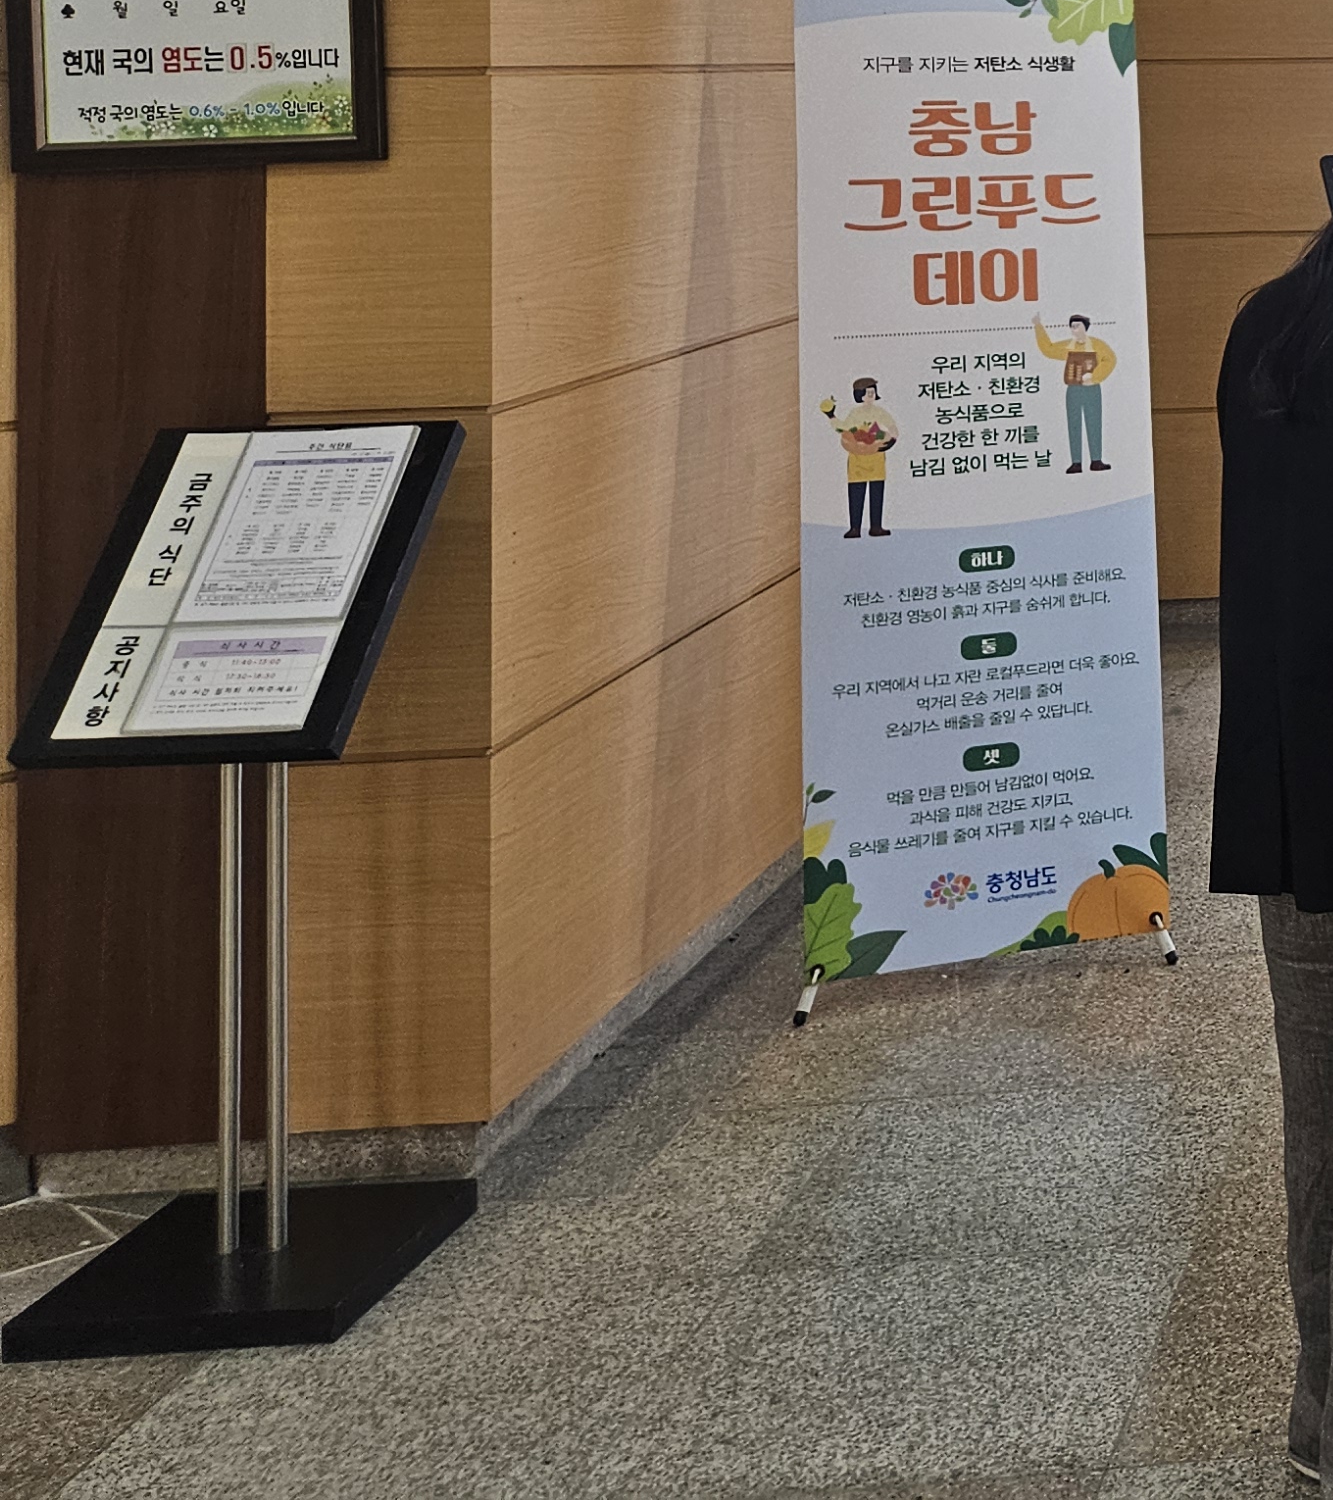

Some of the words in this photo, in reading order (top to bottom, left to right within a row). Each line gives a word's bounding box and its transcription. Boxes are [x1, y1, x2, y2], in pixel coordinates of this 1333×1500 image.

[113, 1, 128, 18] 월
[163, 0, 179, 17] 일
[62, 49, 105, 77] 현재
[113, 47, 153, 74] 국의
[162, 46, 224, 73] 염도는
[863, 55, 913, 73] 지구를
[919, 56, 968, 73] 지키는
[974, 56, 1022, 73] 저탄소
[1028, 55, 1075, 72] 식생활
[78, 107, 107, 123] 적정
[110, 104, 138, 121] 국의
[141, 104, 183, 122] 염도는
[189, 103, 225, 119] 0.6%
[243, 100, 325, 117] 1.0%입니다
[908, 100, 1037, 157] 충남
[843, 173, 1101, 232] 그린푸드
[913, 248, 1038, 306] 데이
[931, 355, 967, 374] 우리
[973, 351, 1026, 372] 지역의
[918, 380, 971, 399] 저탄소
[988, 376, 1040, 396] 친환경
[935, 402, 1024, 424] 농식품으로
[921, 429, 975, 451] 건강한
[980, 428, 997, 446] 한
[1004, 426, 1039, 444] 끼를
[910, 457, 945, 478] 남김
[951, 455, 988, 475] 없이
[993, 452, 1028, 472] 먹는
[1035, 450, 1052, 469] 날
[169, 472, 214, 536] 금주의
[148, 543, 183, 587] 식단
[971, 550, 1003, 568] 하나
[844, 590, 884, 607] 저탄소
[897, 584, 938, 602] 친환경
[942, 580, 982, 599] 농식품
[986, 575, 1026, 595] 중심의
[1029, 573, 1067, 590] 식사를
[1072, 567, 1126, 585] 준비해요.
[861, 610, 902, 628] 친환경
[907, 607, 947, 624] 영농이
[951, 603, 978, 620] 흙과
[982, 599, 1022, 616] 지구를
[1026, 595, 1066, 613] 숨쉬게
[1069, 590, 1111, 608] 합니다.
[981, 638, 997, 655] 둘
[84, 635, 140, 728] 공지사항
[833, 682, 860, 698] 우리
[865, 676, 919, 695] 지역에서
[924, 674, 951, 689] 나고
[955, 670, 982, 686] 자란
[985, 661, 1064, 682] 로컬푸드라면
[1069, 657, 1095, 673] 더욱
[1098, 651, 1139, 670] 좋아요.
[916, 692, 956, 710] 먹거리
[961, 690, 988, 707] 운송
[992, 686, 1032, 703] 거리를
[1036, 683, 1063, 699] 줄여
[886, 719, 940, 739] 온실가스
[944, 715, 984, 732] 배출을
[989, 710, 1016, 728] 줄일
[1020, 709, 1033, 722] 수
[1038, 701, 1093, 720] 있답니다.
[983, 748, 1000, 766] 셋
[886, 790, 914, 806] 먹을
[919, 787, 946, 803] 만큼
[951, 781, 990, 799] 만들어
[994, 773, 1048, 793] 남김없이
[1052, 766, 1095, 785] 먹어요.
[910, 809, 951, 826] 과식을
[955, 805, 982, 821] 피해
[987, 799, 1027, 816] 건강도
[848, 841, 890, 859] 음식물
[895, 833, 948, 852] 쓰레기를
[953, 827, 981, 844] 줄여
[985, 823, 1026, 840] 지구를
[1029, 819, 1055, 835] 지킬
[1059, 816, 1072, 831] 수
[1078, 807, 1133, 827] 있습니다.
[986, 865, 1058, 894] 충청남도
